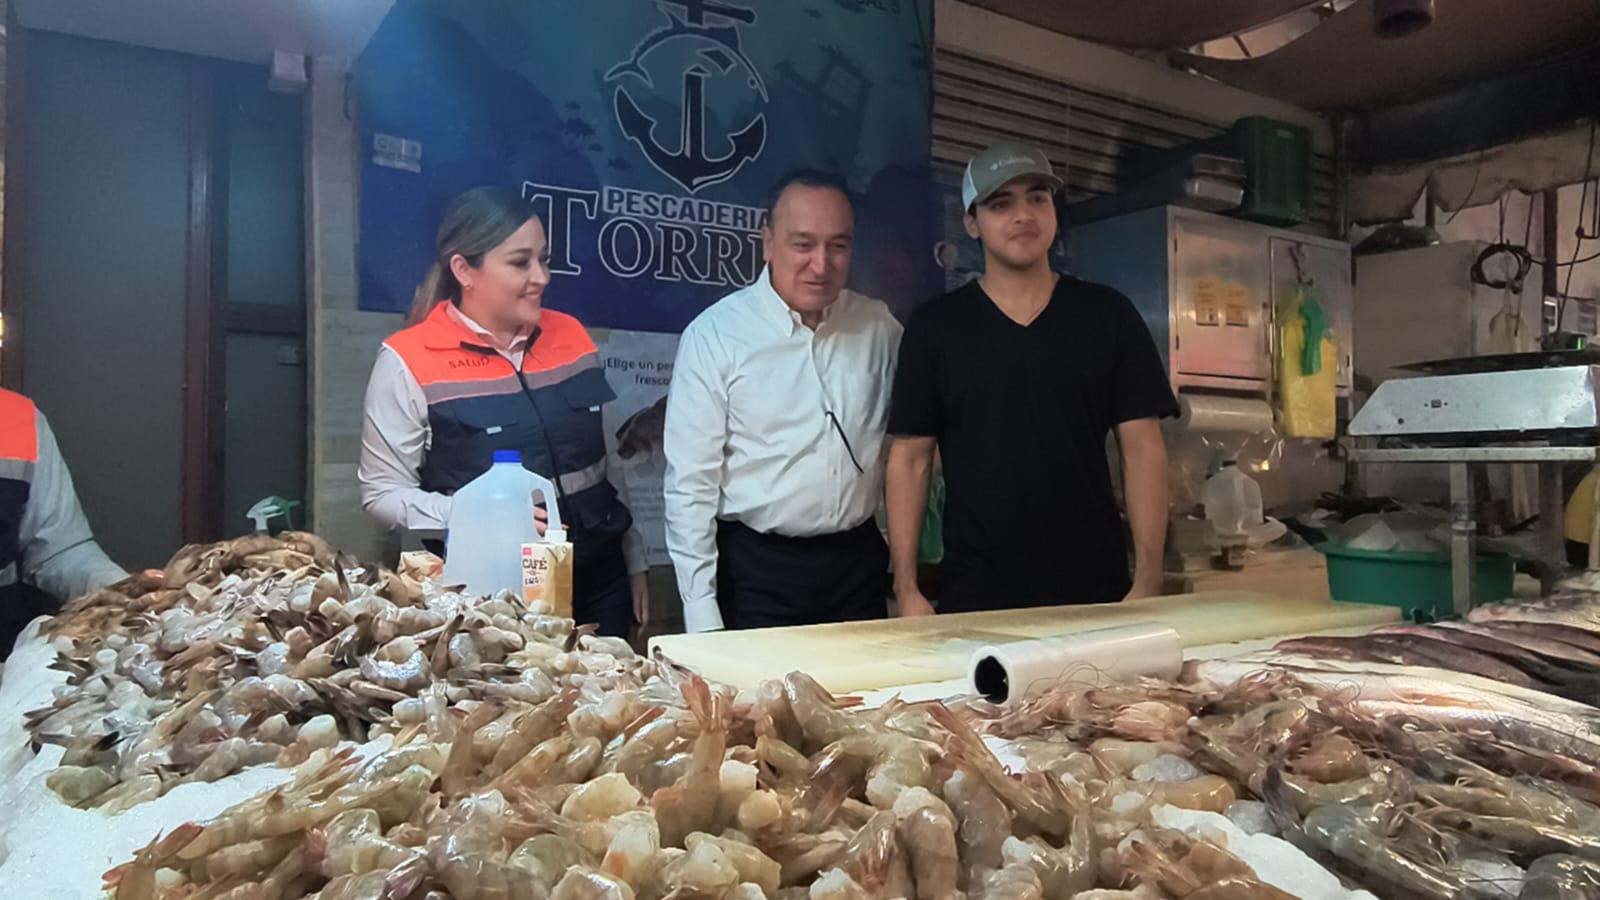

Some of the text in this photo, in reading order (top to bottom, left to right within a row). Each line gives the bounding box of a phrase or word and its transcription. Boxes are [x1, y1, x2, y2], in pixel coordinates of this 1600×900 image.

[603, 187, 769, 230] PESCADERIA
[448, 356, 489, 368] SALUD
[638, 360, 653, 369] un
